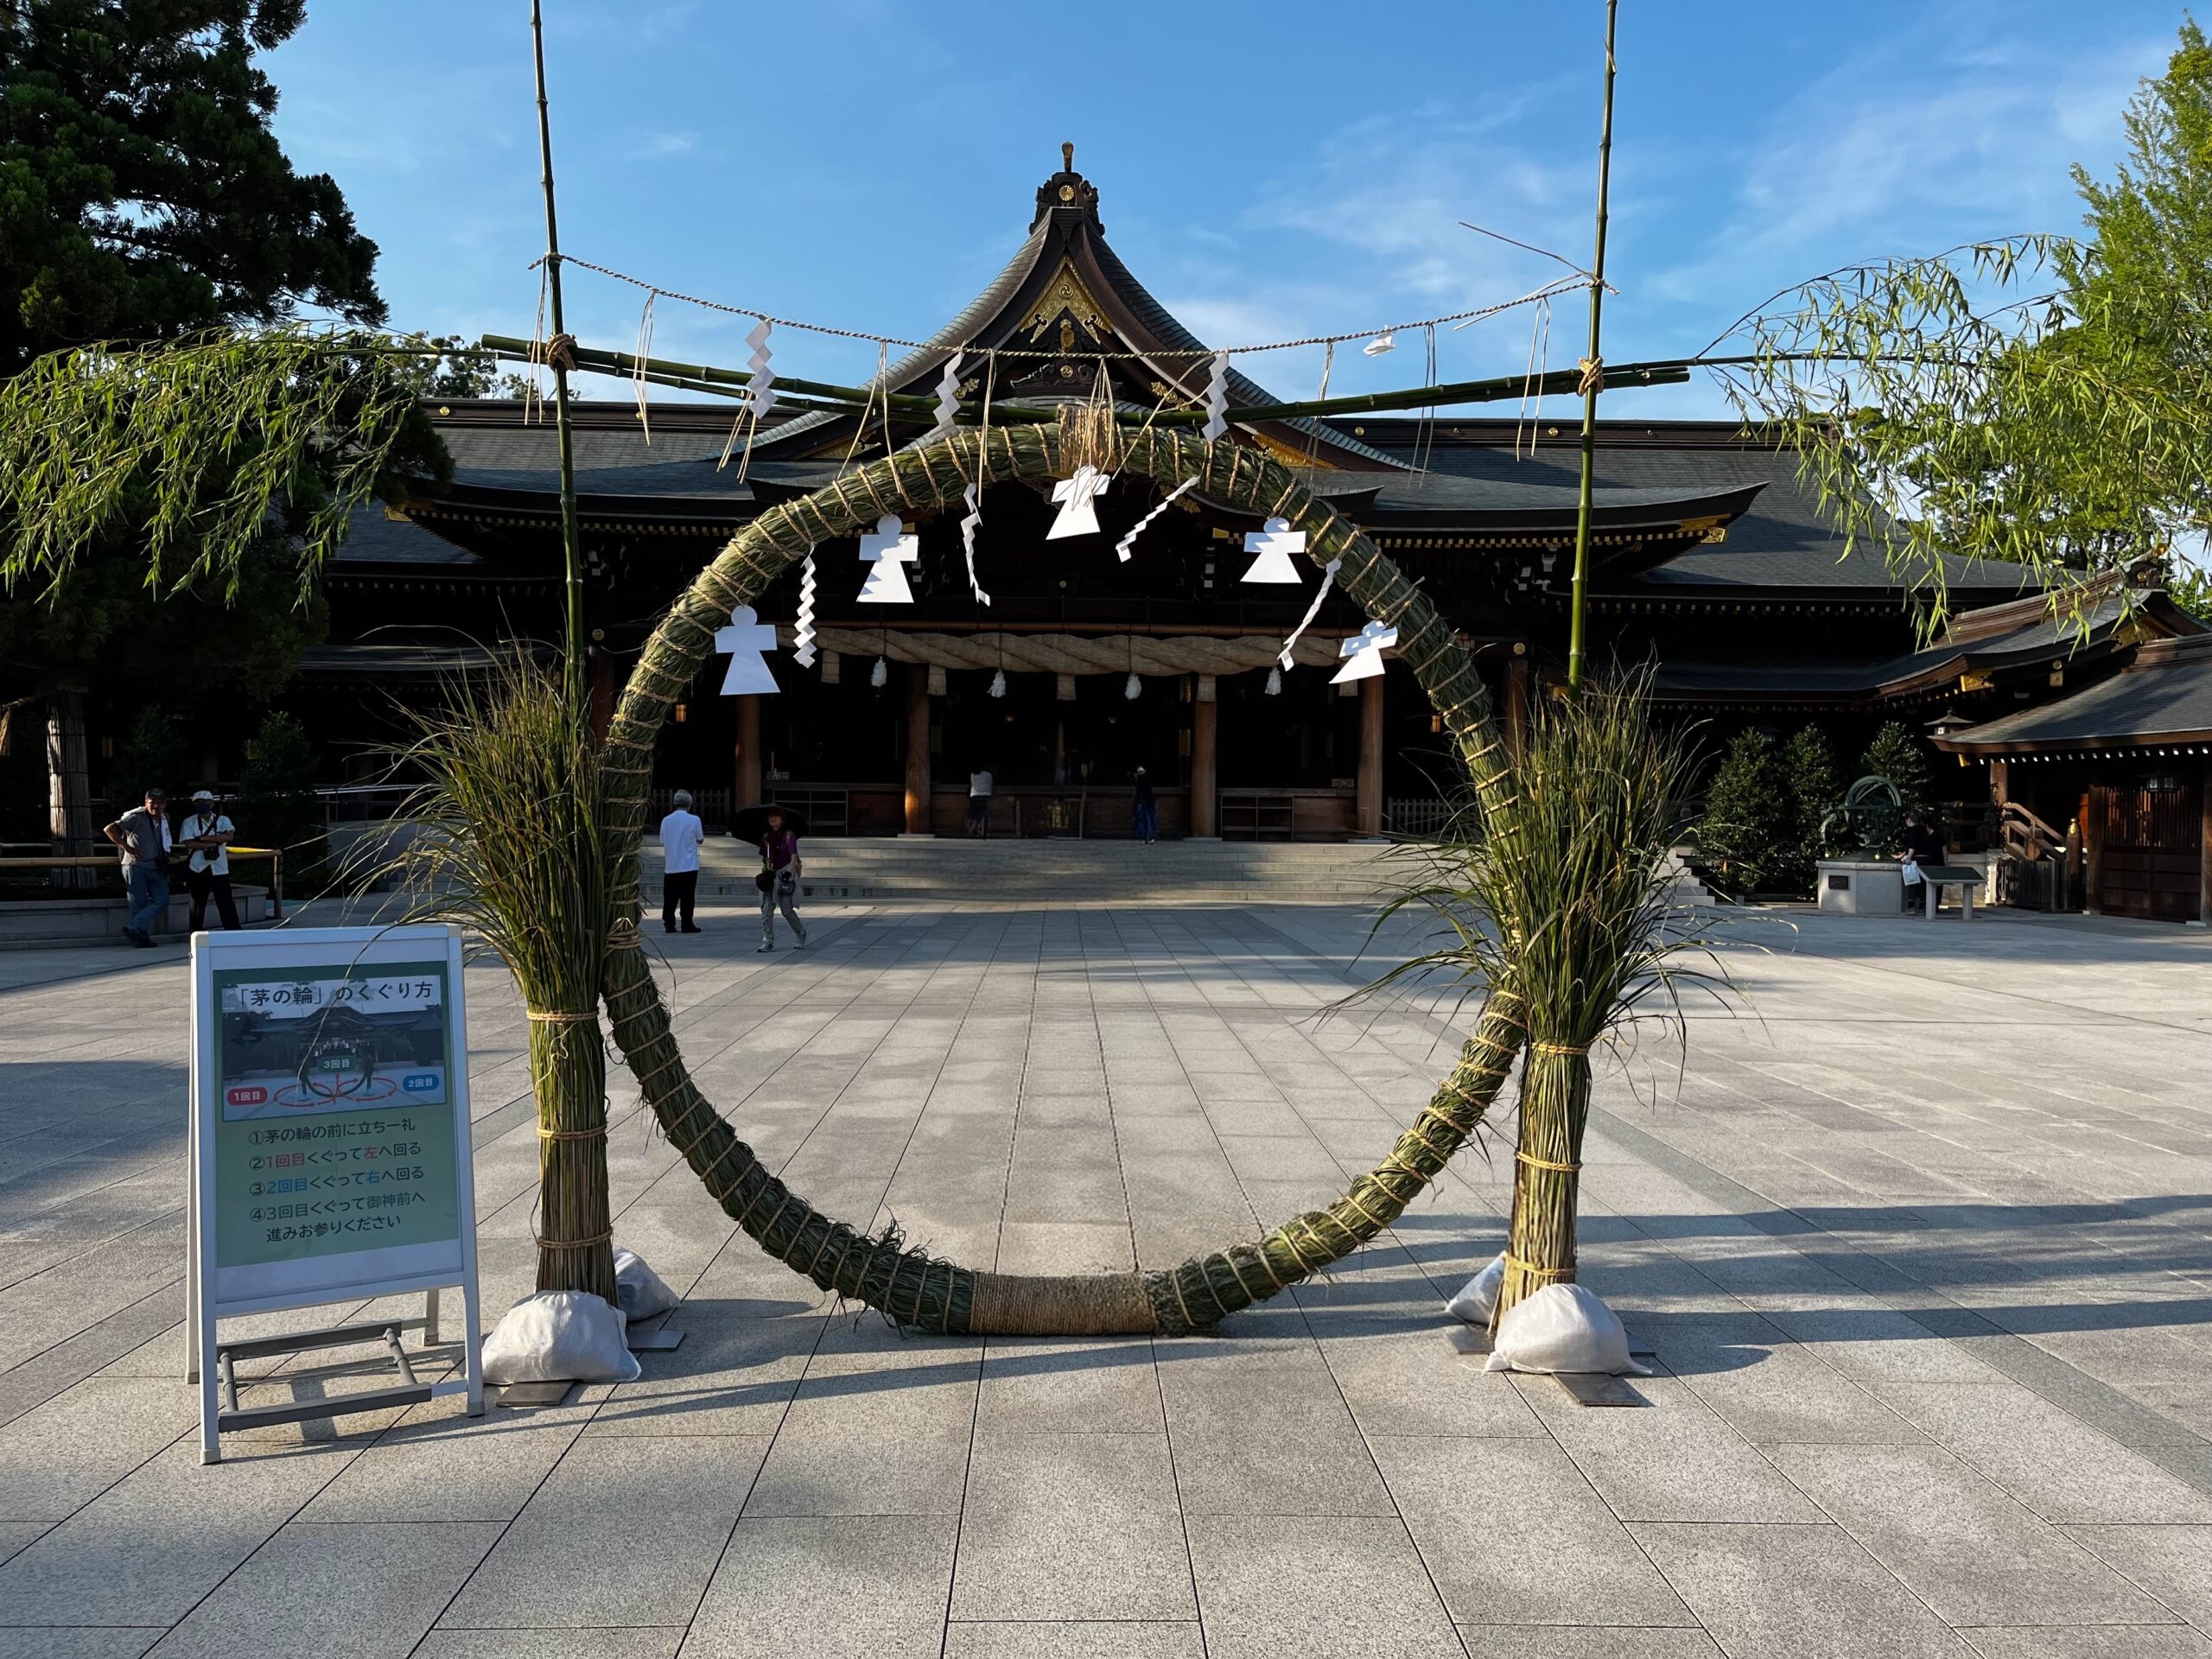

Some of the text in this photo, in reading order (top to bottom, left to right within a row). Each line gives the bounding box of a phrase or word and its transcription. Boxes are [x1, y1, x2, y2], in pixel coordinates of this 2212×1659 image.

[323, 1058, 350, 1070] 3回目
[408, 1077, 434, 1088] 2回目
[234, 1090, 261, 1102] 1回目
[266, 1214, 401, 1243] 進みお参りください
